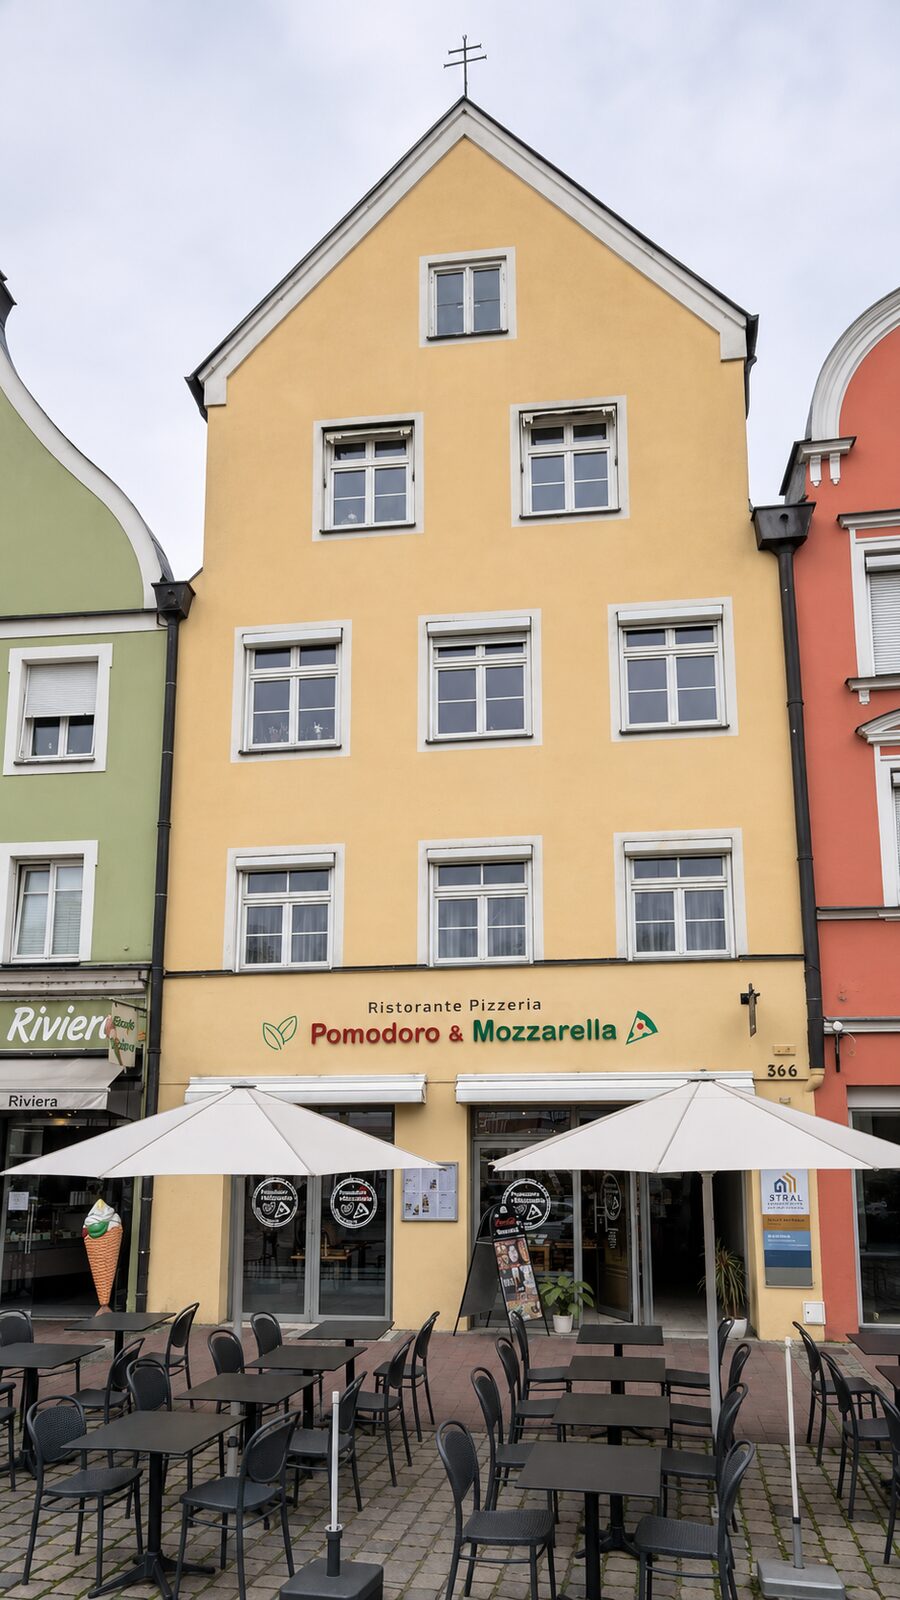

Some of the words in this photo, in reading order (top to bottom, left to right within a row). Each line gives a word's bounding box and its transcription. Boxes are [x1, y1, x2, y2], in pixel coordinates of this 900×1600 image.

[369, 1000, 462, 1014] Ristorante
[469, 997, 542, 1013] Pizzeria
[310, 1022, 441, 1047] Pomodoro
[448, 1025, 465, 1043] &
[472, 1017, 617, 1043] Mozzarella
[767, 1064, 798, 1077] 366
[8, 1095, 58, 1107] Riviera
[769, 1194, 803, 1202] STRAL
